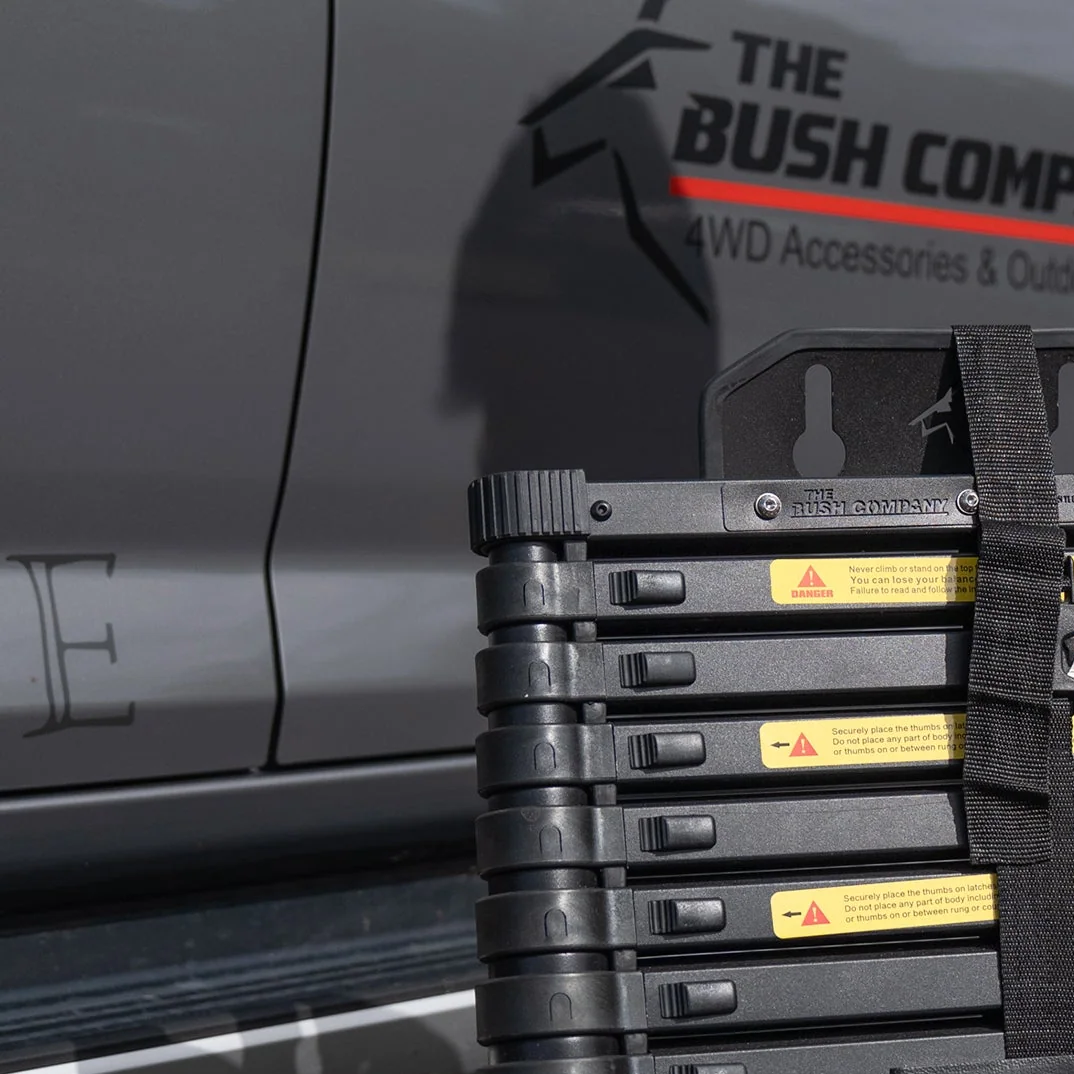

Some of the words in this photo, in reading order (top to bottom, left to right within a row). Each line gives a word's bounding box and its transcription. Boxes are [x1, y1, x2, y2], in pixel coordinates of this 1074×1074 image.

[730, 30, 848, 99] THE
[673, 92, 889, 189] BUSH
[684, 214, 772, 264] 4WD
[781, 225, 968, 286] Accessories
[977, 250, 998, 286] &
[804, 488, 834, 501] THE
[792, 500, 846, 516] BUSH
[852, 498, 949, 515] COMPANY
[848, 565, 873, 573] Never
[875, 565, 897, 573] climb
[909, 565, 932, 573] stand
[946, 564, 958, 572] the
[960, 564, 974, 573] top
[850, 576, 869, 584] You
[892, 576, 914, 584] lose
[916, 577, 939, 586] your
[941, 576, 975, 584] balanc
[791, 590, 833, 598] DANGER
[850, 587, 880, 595] Failure
[891, 586, 910, 594] read
[911, 586, 927, 594] and
[928, 585, 953, 594] follow
[954, 585, 968, 593] the
[6, 553, 135, 738] E
[831, 726, 869, 735] Securely
[871, 726, 893, 734] place
[910, 723, 941, 732] thumbs
[832, 737, 845, 746] Do
[846, 737, 860, 745] not
[862, 736, 884, 745] place
[887, 736, 902, 744] any
[904, 734, 921, 743] part
[922, 733, 930, 741] of
[932, 733, 953, 742] body
[844, 747, 876, 755] thumbs
[900, 744, 936, 752] between
[937, 743, 957, 751] rung
[843, 892, 881, 903] Securely
[883, 891, 905, 900] place
[907, 889, 921, 897] the
[922, 886, 953, 896] thumbs
[955, 885, 966, 893] on
[844, 904, 857, 913] Do
[874, 902, 897, 911] place
[899, 900, 914, 908] any
[916, 899, 933, 908] part
[934, 897, 943, 905] of
[945, 895, 966, 905] body
[856, 913, 888, 922] thumbs
[912, 907, 949, 917] between
[950, 905, 970, 914] rung
[971, 904, 980, 912] or
